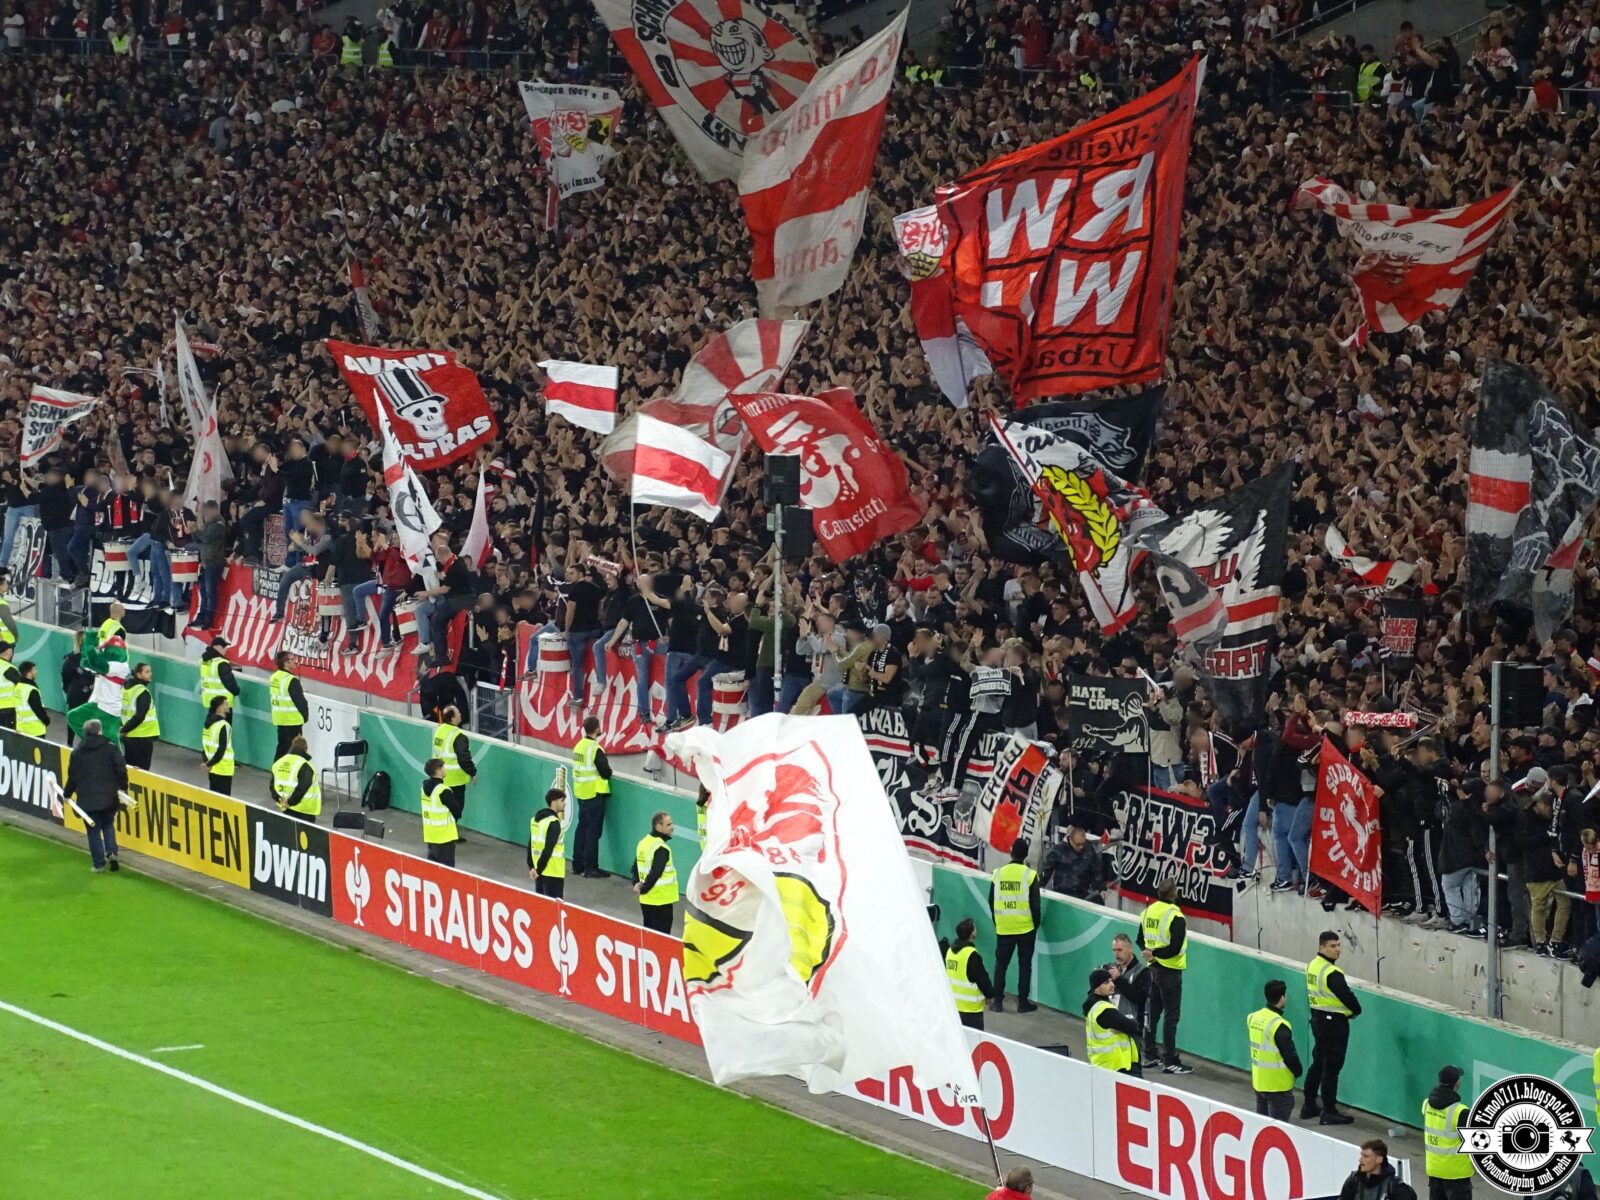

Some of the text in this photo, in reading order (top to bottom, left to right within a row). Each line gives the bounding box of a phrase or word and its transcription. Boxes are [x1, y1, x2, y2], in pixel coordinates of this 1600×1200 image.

[343, 353, 448, 376] AVANT
[1072, 685, 1106, 699] HATE
[1089, 697, 1120, 711] COPS
[317, 705, 333, 732] 35
[1072, 736, 1097, 749] 1312
[254, 821, 327, 903] bwin
[700, 880, 746, 907] 93
[1000, 881, 1021, 892] SECURITY
[1003, 901, 1017, 909] 1463
[385, 868, 534, 969] STRAUSS
[596, 934, 691, 1024] STRA
[1115, 1082, 1304, 1200] ERGO
